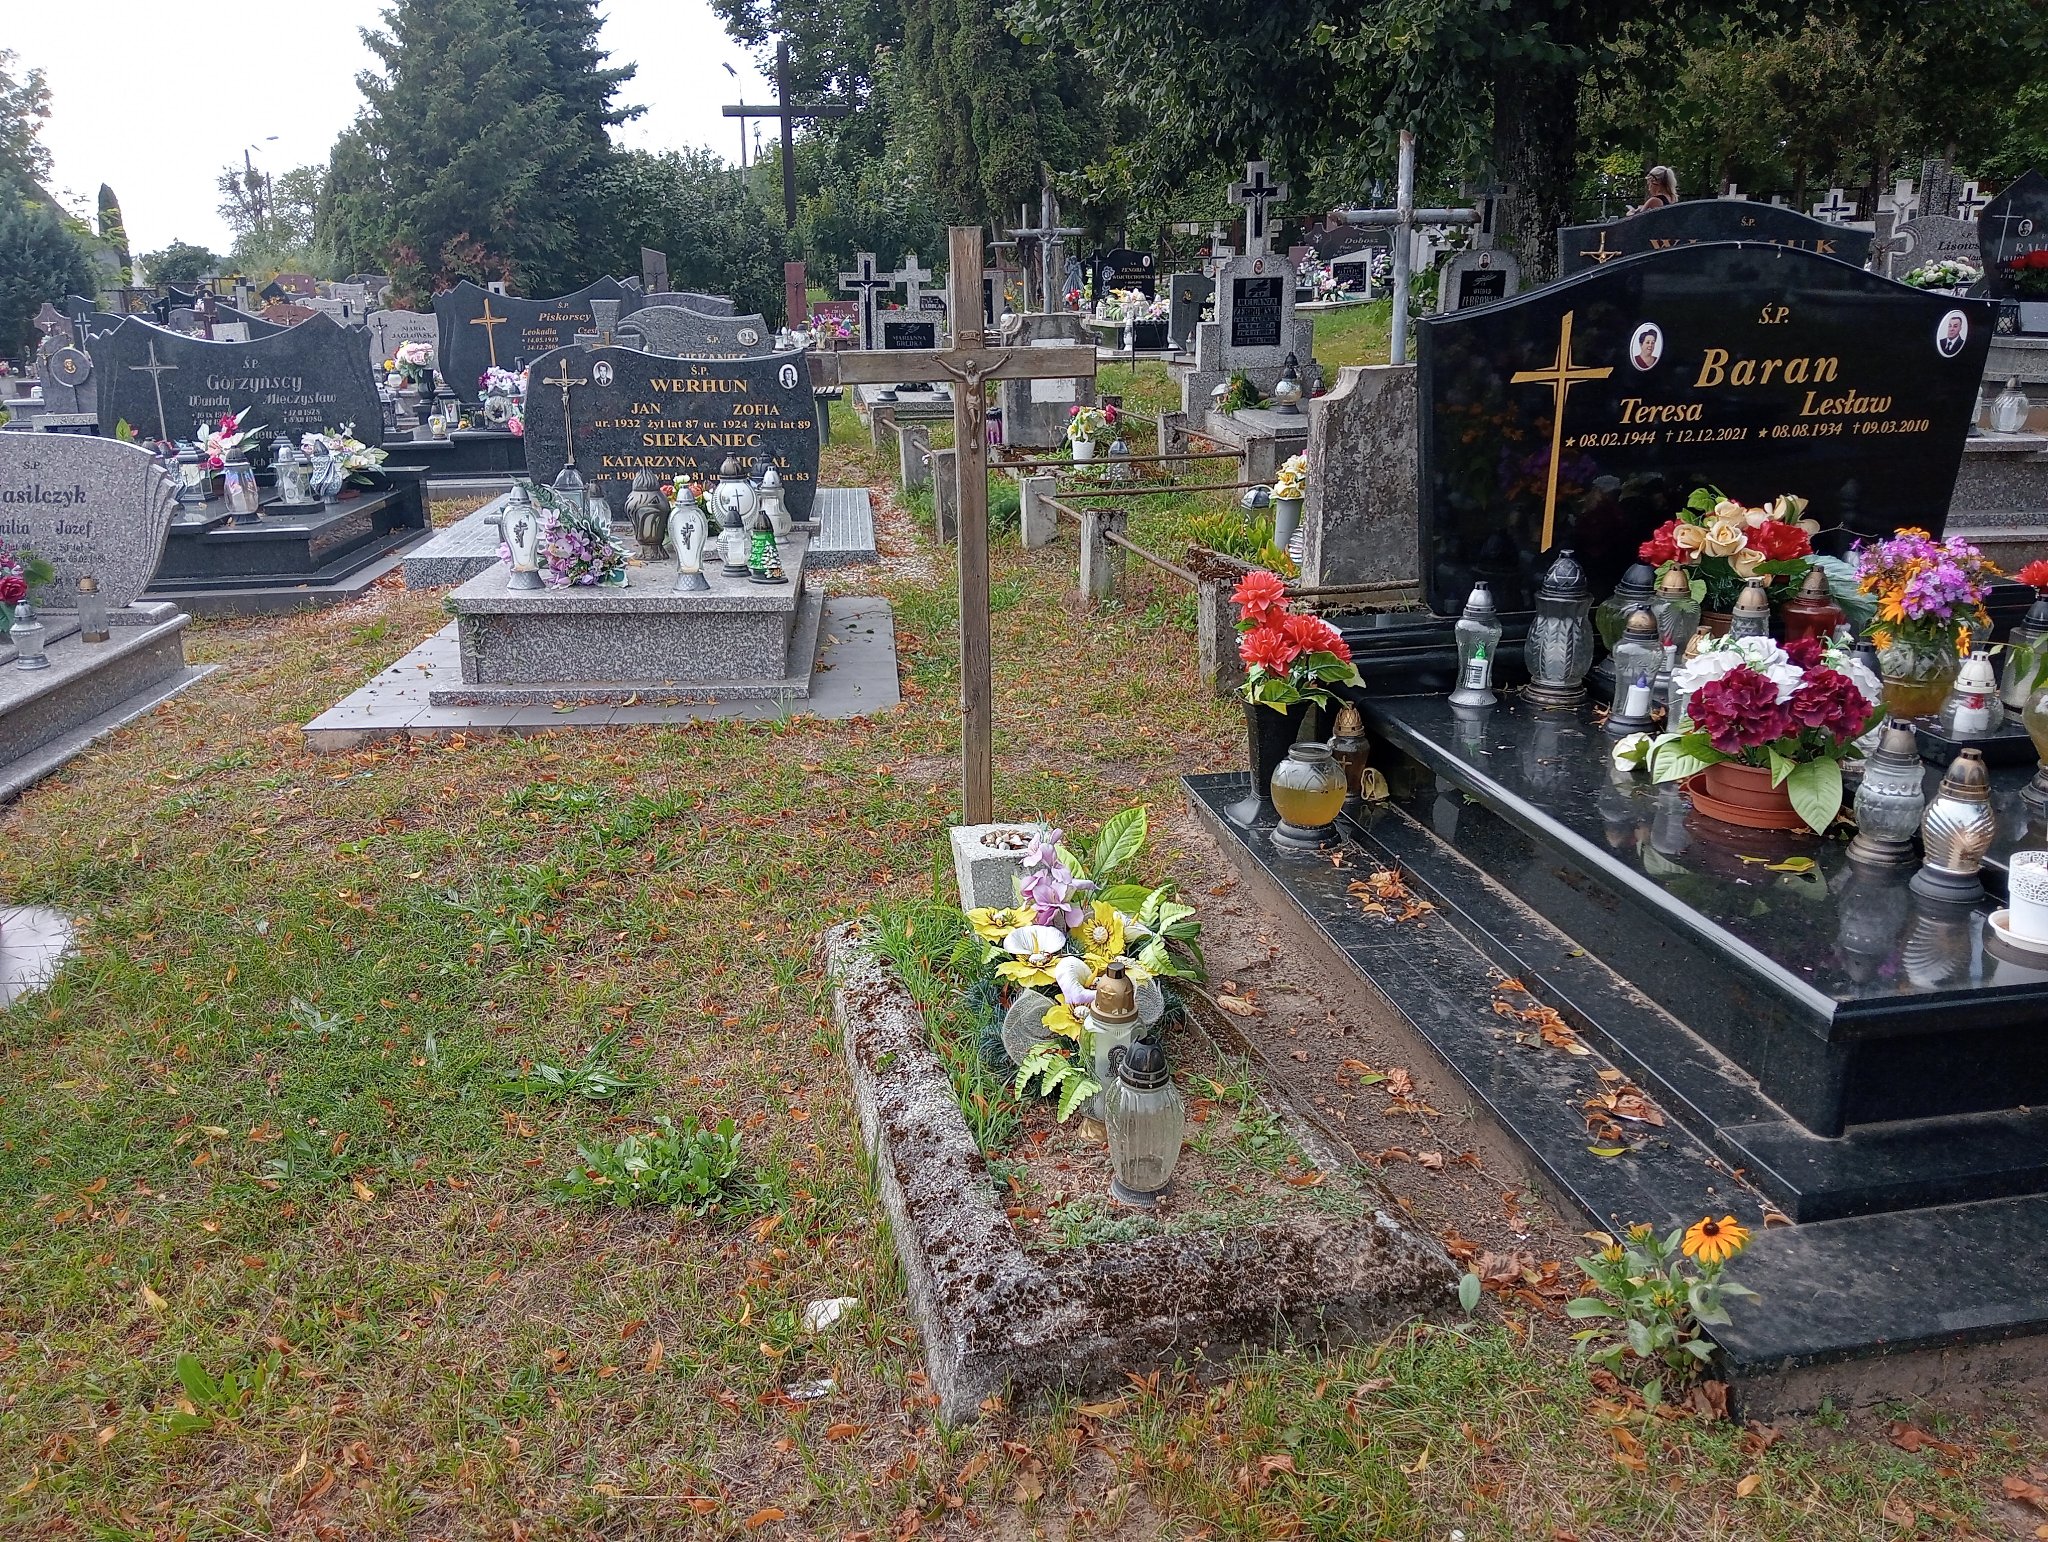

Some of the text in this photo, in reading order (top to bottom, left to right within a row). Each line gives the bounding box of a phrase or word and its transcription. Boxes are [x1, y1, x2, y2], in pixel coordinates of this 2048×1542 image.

[1936, 242, 1981, 251] Lisows
[538, 312, 592, 322] Piskorscy
[1758, 302, 1790, 324] Ś.P.
[1693, 348, 1838, 388] Baran
[650, 379, 748, 393] WERHUN
[188, 396, 230, 406] Wanda
[1618, 390, 1892, 424] Teresa Lesław
[630, 403, 780, 416] JAN ZOFIA
[595, 420, 610, 428] ur.
[614, 420, 640, 428] 1932
[668, 420, 682, 428] lat
[686, 420, 699, 428] 87
[703, 421, 718, 429] ur.
[722, 420, 748, 429] 1924
[780, 420, 794, 429] lat
[798, 420, 811, 429] 89
[642, 432, 760, 447] SIEKANIEC
[1578, 419, 1930, 448] 08.02.1944 12.12.2021 08.08.1934 09.03.2010
[602, 455, 698, 467] KATARZYNA
[597, 472, 612, 480] ur.
[616, 472, 639, 480] 190
[692, 472, 704, 480] 81
[780, 472, 794, 481] at
[796, 472, 810, 481] 83
[0, 484, 87, 508] asilczyk
